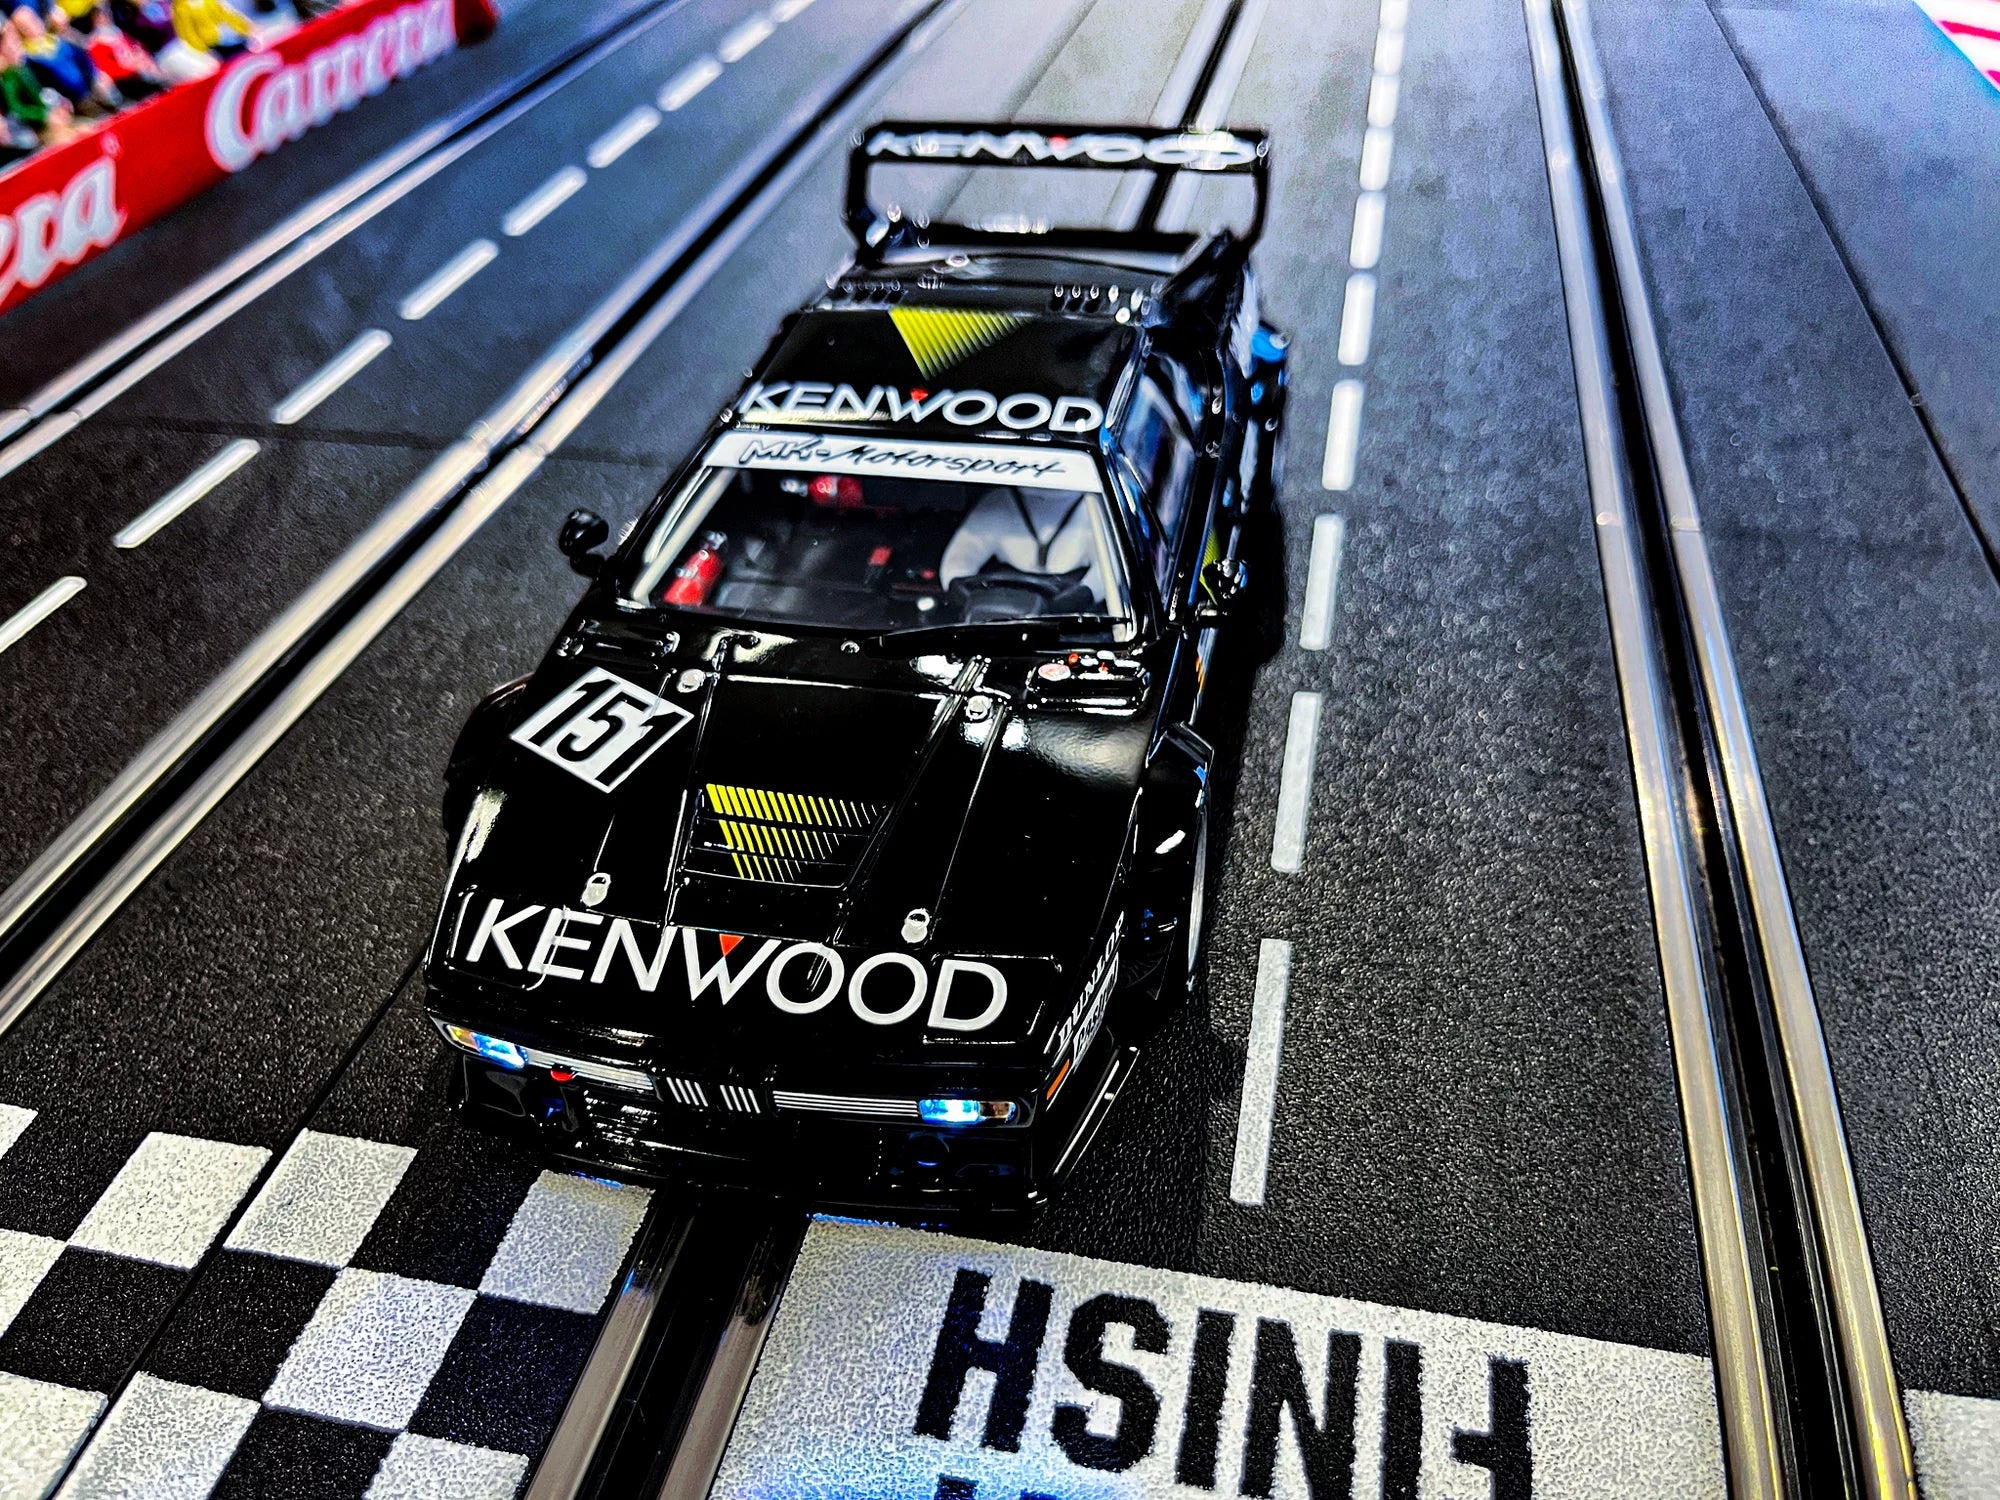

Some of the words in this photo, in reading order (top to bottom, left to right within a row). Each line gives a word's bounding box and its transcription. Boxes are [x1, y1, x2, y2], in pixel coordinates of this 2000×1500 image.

[206, 0, 457, 172] Carrera
[866, 129, 1258, 164] KENWOOD
[737, 381, 1104, 433] KENWOOD
[738, 433, 1066, 478] MK-Motorsport
[527, 678, 688, 787] 151
[466, 898, 1008, 1031] KENWOOD
[1058, 910, 1124, 1046] DUNLOP
[914, 1266, 1534, 1500] FINISH
